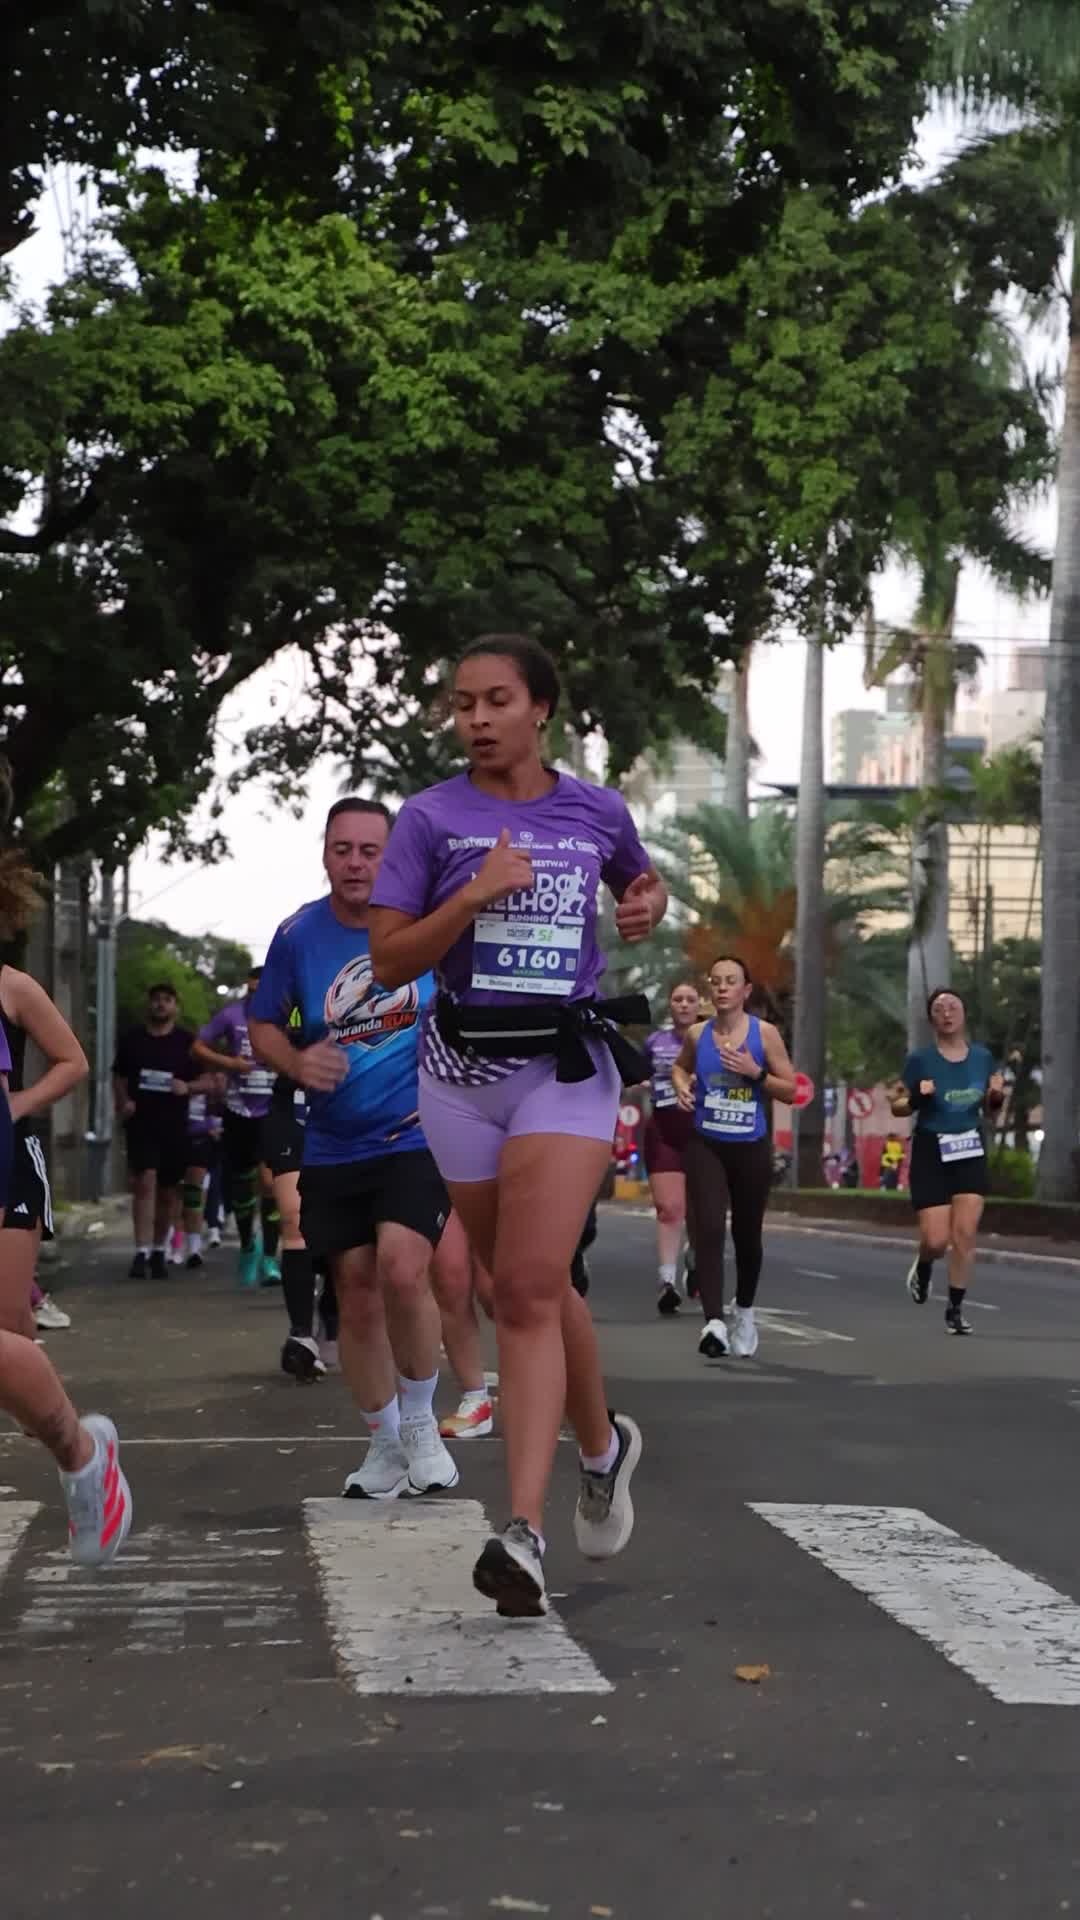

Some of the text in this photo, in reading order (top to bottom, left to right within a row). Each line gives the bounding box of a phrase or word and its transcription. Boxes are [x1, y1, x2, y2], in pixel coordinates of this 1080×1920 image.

[448, 837, 498, 850] Bestway
[531, 859, 569, 868] BESTWAY
[507, 914, 550, 923] RUNNING
[497, 947, 560, 970] 6160
[713, 1110, 745, 1123] 5332
